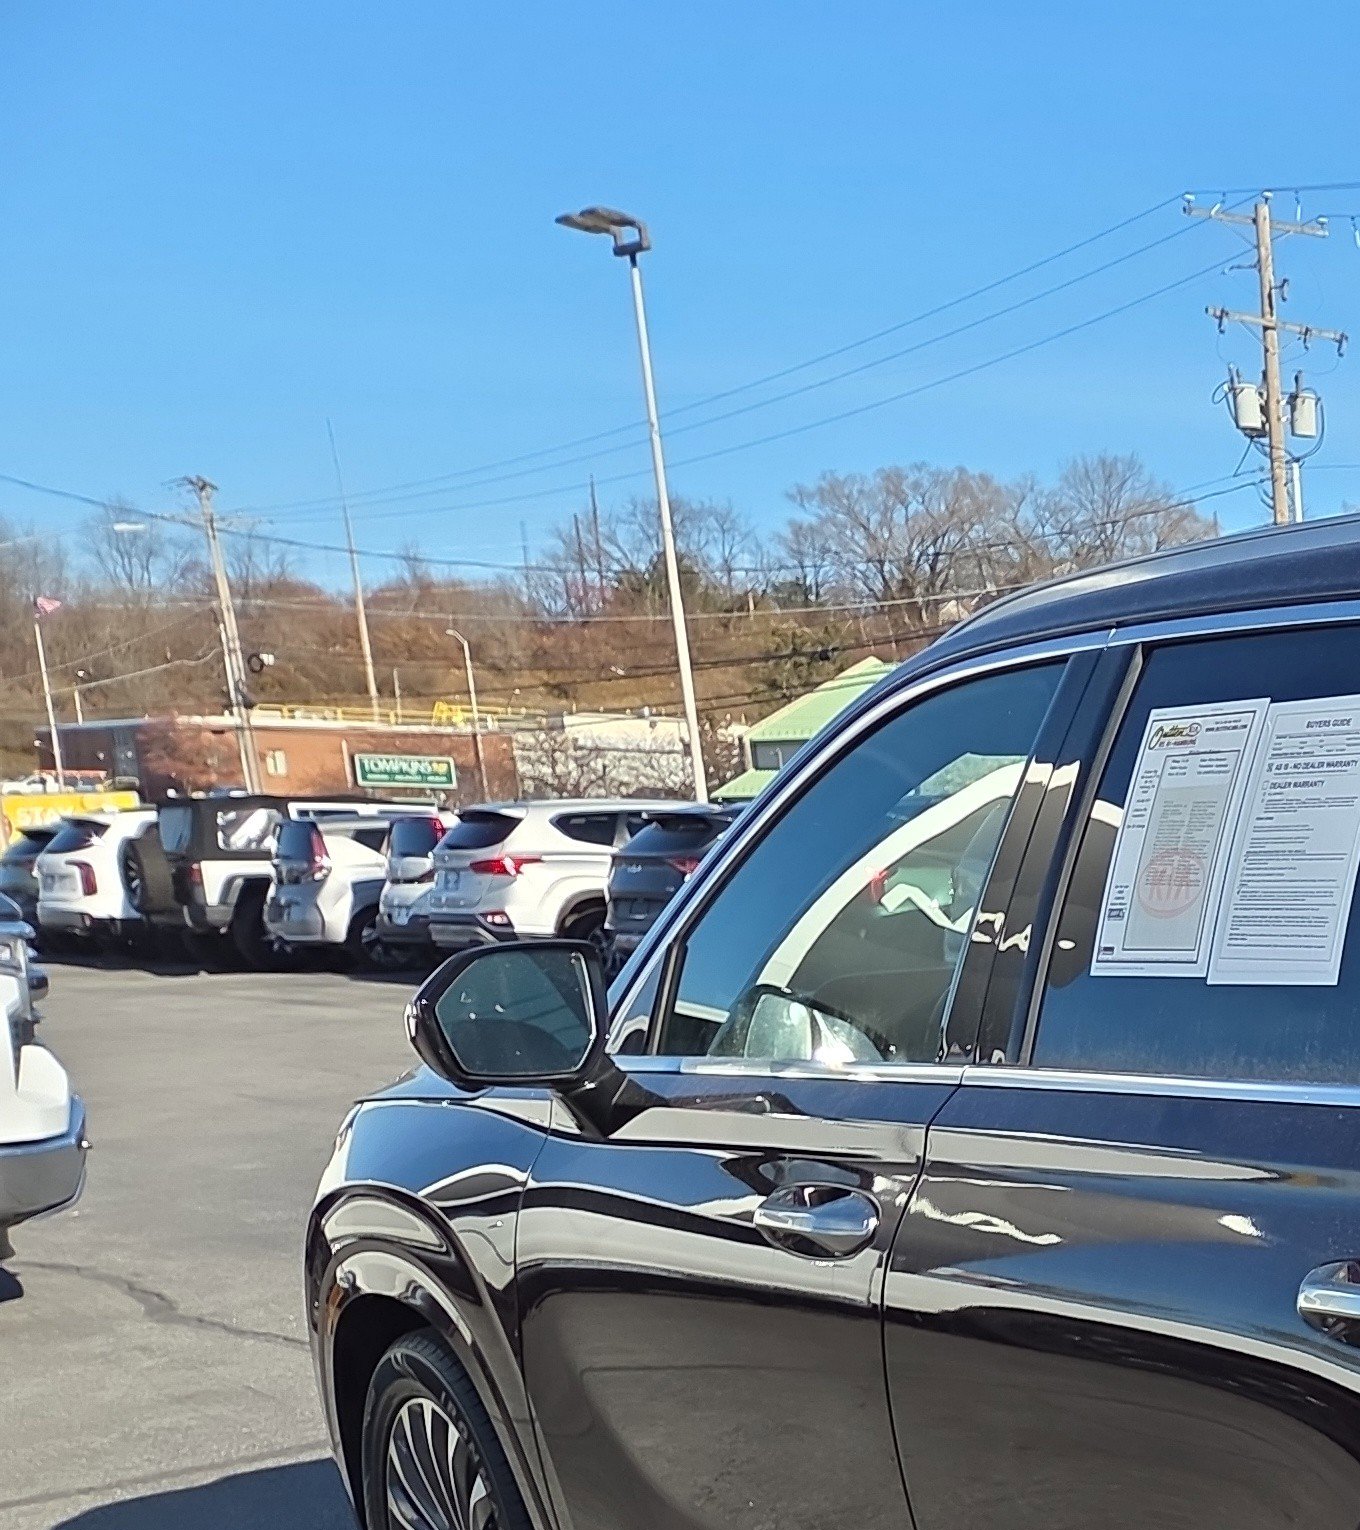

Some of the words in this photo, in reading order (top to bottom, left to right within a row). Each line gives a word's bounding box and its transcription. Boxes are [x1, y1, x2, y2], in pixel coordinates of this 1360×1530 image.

[363, 758, 433, 775] TOMPKINS
[1302, 761, 1325, 770] DEALER
[1326, 760, 1358, 768] WARRANTY
[1270, 782, 1292, 790] DEALER
[1293, 780, 1325, 789] WARRANTY
